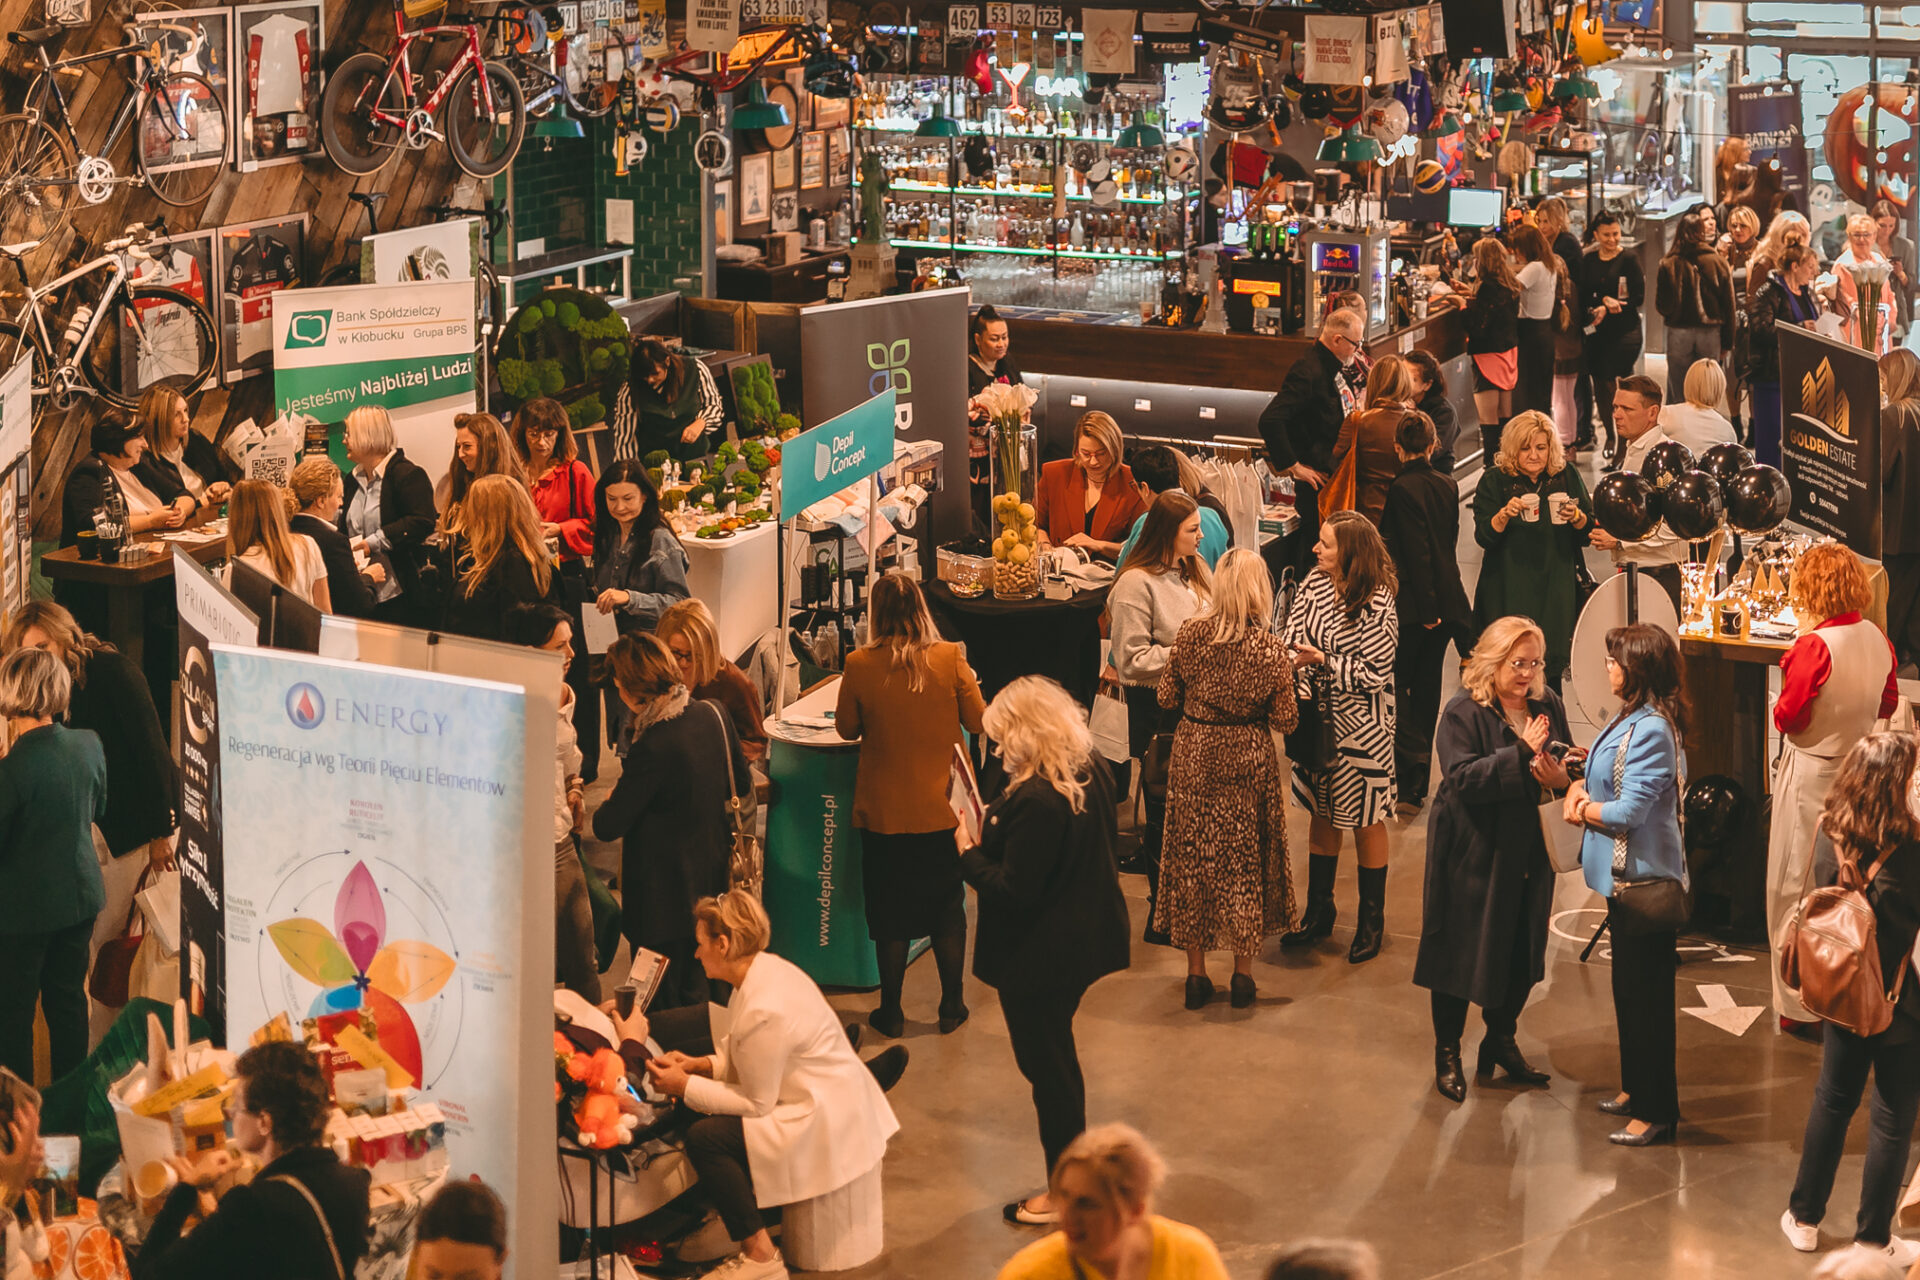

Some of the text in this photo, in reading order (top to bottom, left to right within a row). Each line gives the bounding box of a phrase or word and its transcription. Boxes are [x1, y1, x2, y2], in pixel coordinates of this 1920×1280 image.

[744, 1, 761, 15] 63
[766, 0, 780, 15] 23
[785, 0, 805, 16] 103
[991, 6, 1007, 24] 53
[1016, 9, 1031, 25] 32
[697, 20, 711, 29] WITH
[951, 10, 977, 30] 462
[1038, 10, 1060, 26] 123
[1316, 38, 1352, 48] RIDE BIKES
[1316, 54, 1330, 64] FEEL
[428, 44, 475, 106] TREK
[1035, 75, 1083, 98] BAR
[1322, 259, 1353, 269] Red Bull
[336, 304, 442, 323] Bank Spółdzielczy
[338, 324, 468, 345] w Kłobucku Grupa BPS
[283, 357, 473, 415] Jesteśmy Najbliżej Ludzi
[832, 430, 855, 455] Depil
[1790, 428, 1829, 458] GOLDEN
[1829, 443, 1857, 471] ESTATE
[831, 445, 867, 476] Concept
[335, 697, 449, 737] ENERGY
[228, 735, 313, 769] Regeneracja
[315, 751, 336, 775] wg
[338, 752, 377, 776] Teorii
[380, 759, 422, 785] Pięciu
[184, 799, 201, 823] SWISS
[816, 794, 839, 947] www.depilconcept.pl
